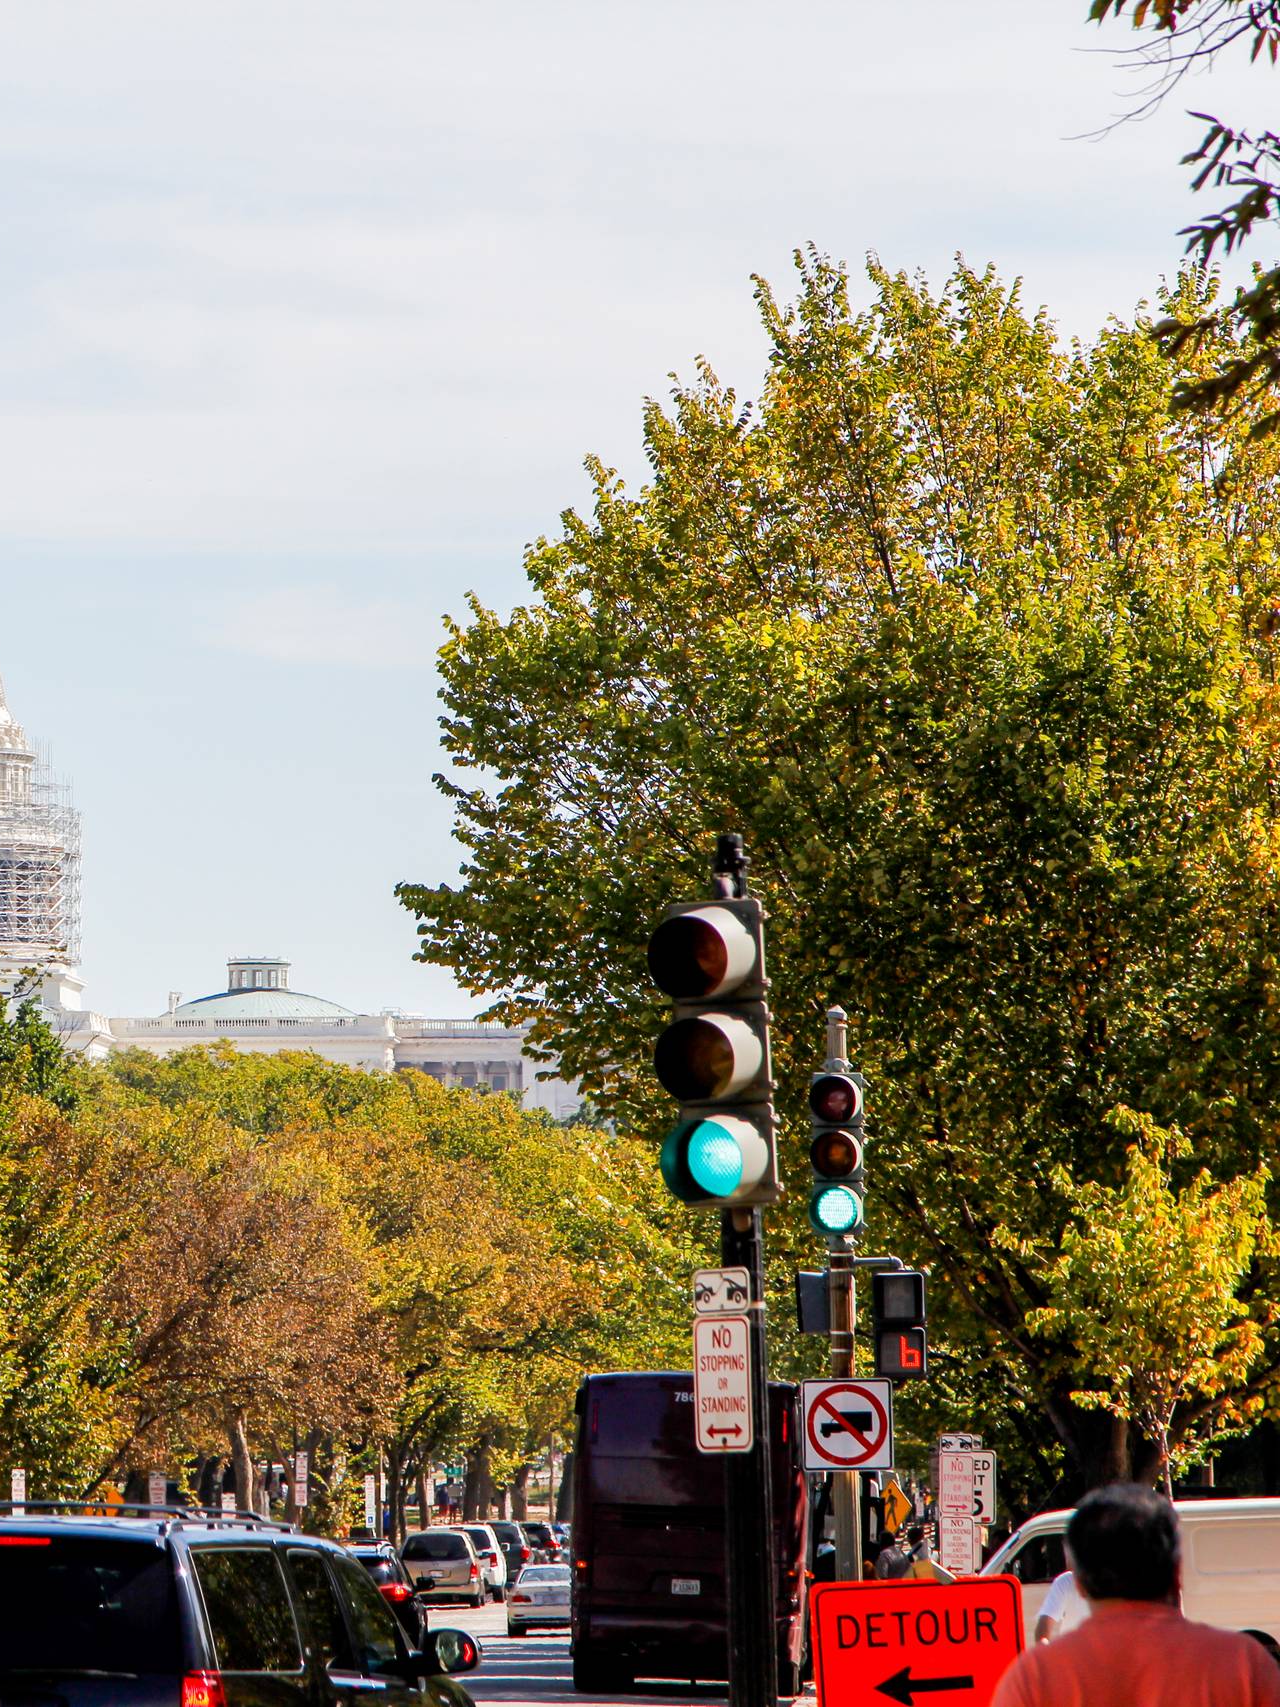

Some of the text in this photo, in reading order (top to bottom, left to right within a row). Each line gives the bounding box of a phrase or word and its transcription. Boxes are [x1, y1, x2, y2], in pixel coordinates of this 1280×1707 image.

[712, 1328, 732, 1348] NO
[700, 1354, 745, 1372] STOPPING
[718, 1376, 728, 1390] OR
[701, 1396, 746, 1413] STANDING
[951, 1461, 964, 1472] NO
[972, 1490, 984, 1516] 5
[837, 1607, 998, 1649] DETOUR
